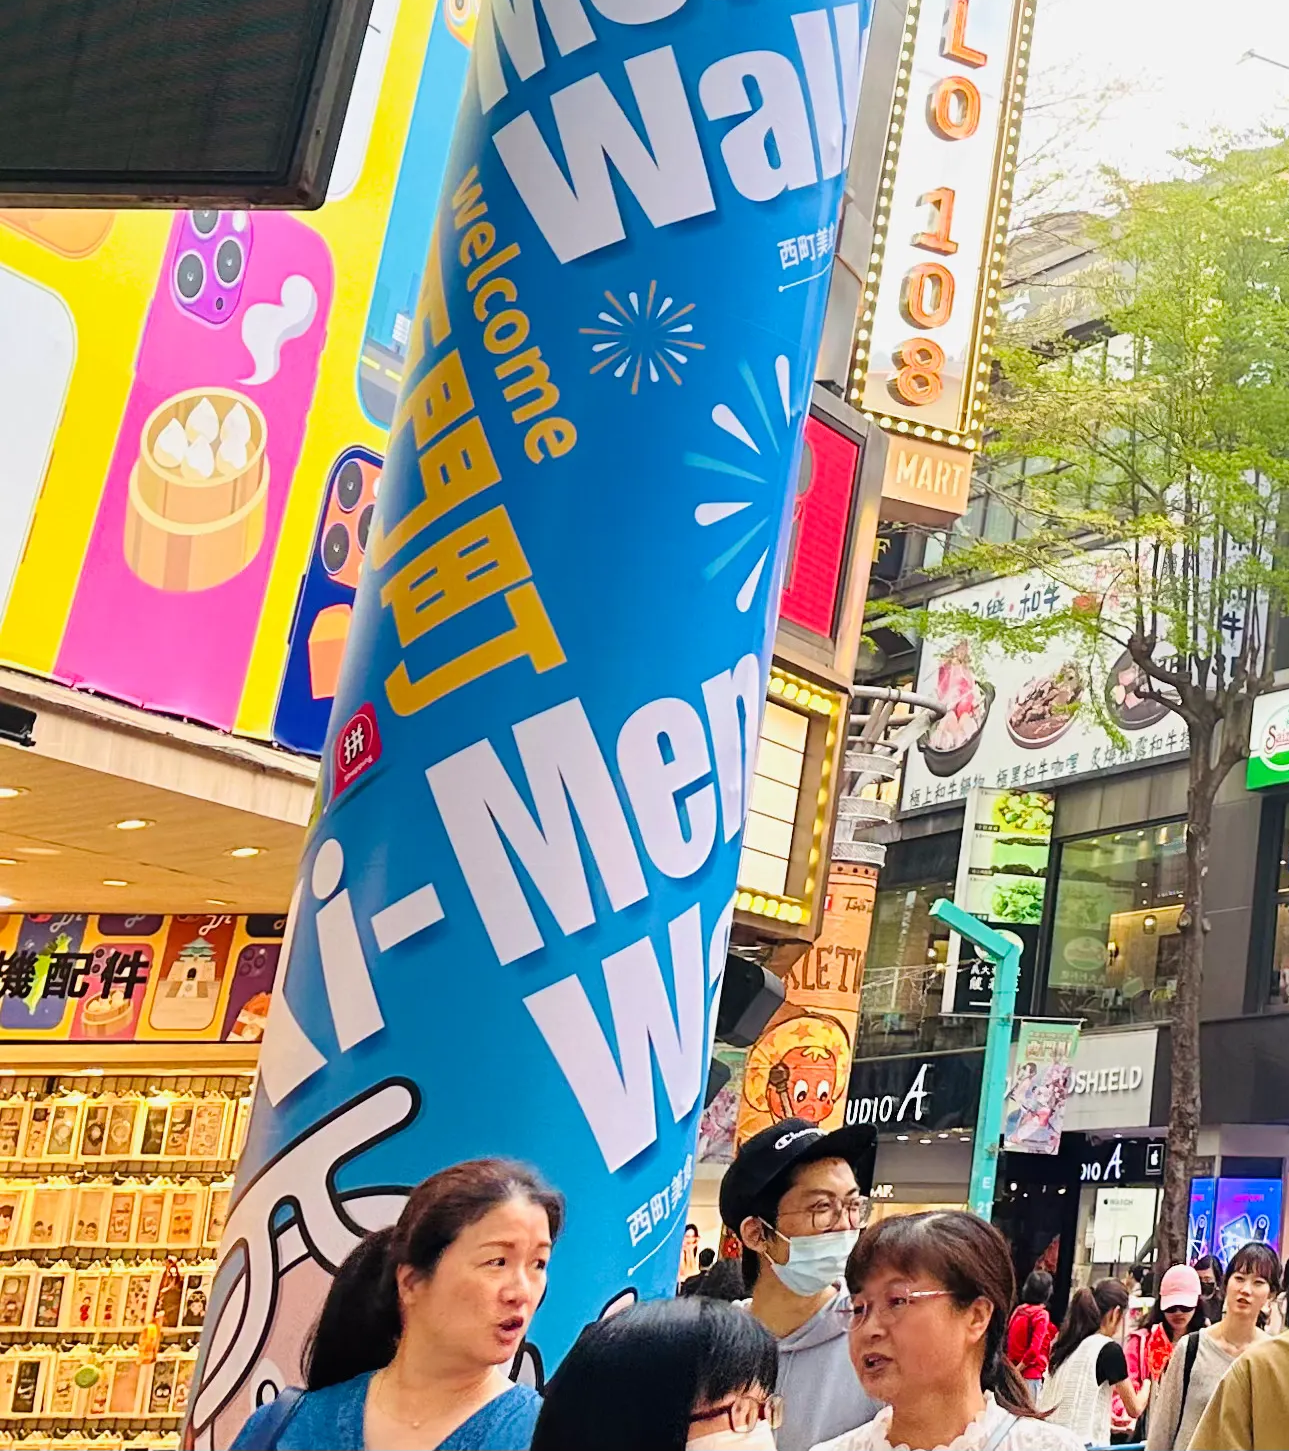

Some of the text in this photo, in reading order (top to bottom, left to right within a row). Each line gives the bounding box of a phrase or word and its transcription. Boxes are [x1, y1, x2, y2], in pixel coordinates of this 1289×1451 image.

[451, 164, 578, 465] welcome
[892, 186, 961, 406] 108
[895, 454, 964, 497] MART
[344, 722, 365, 765] 拼
[897, 1062, 931, 1123] A
